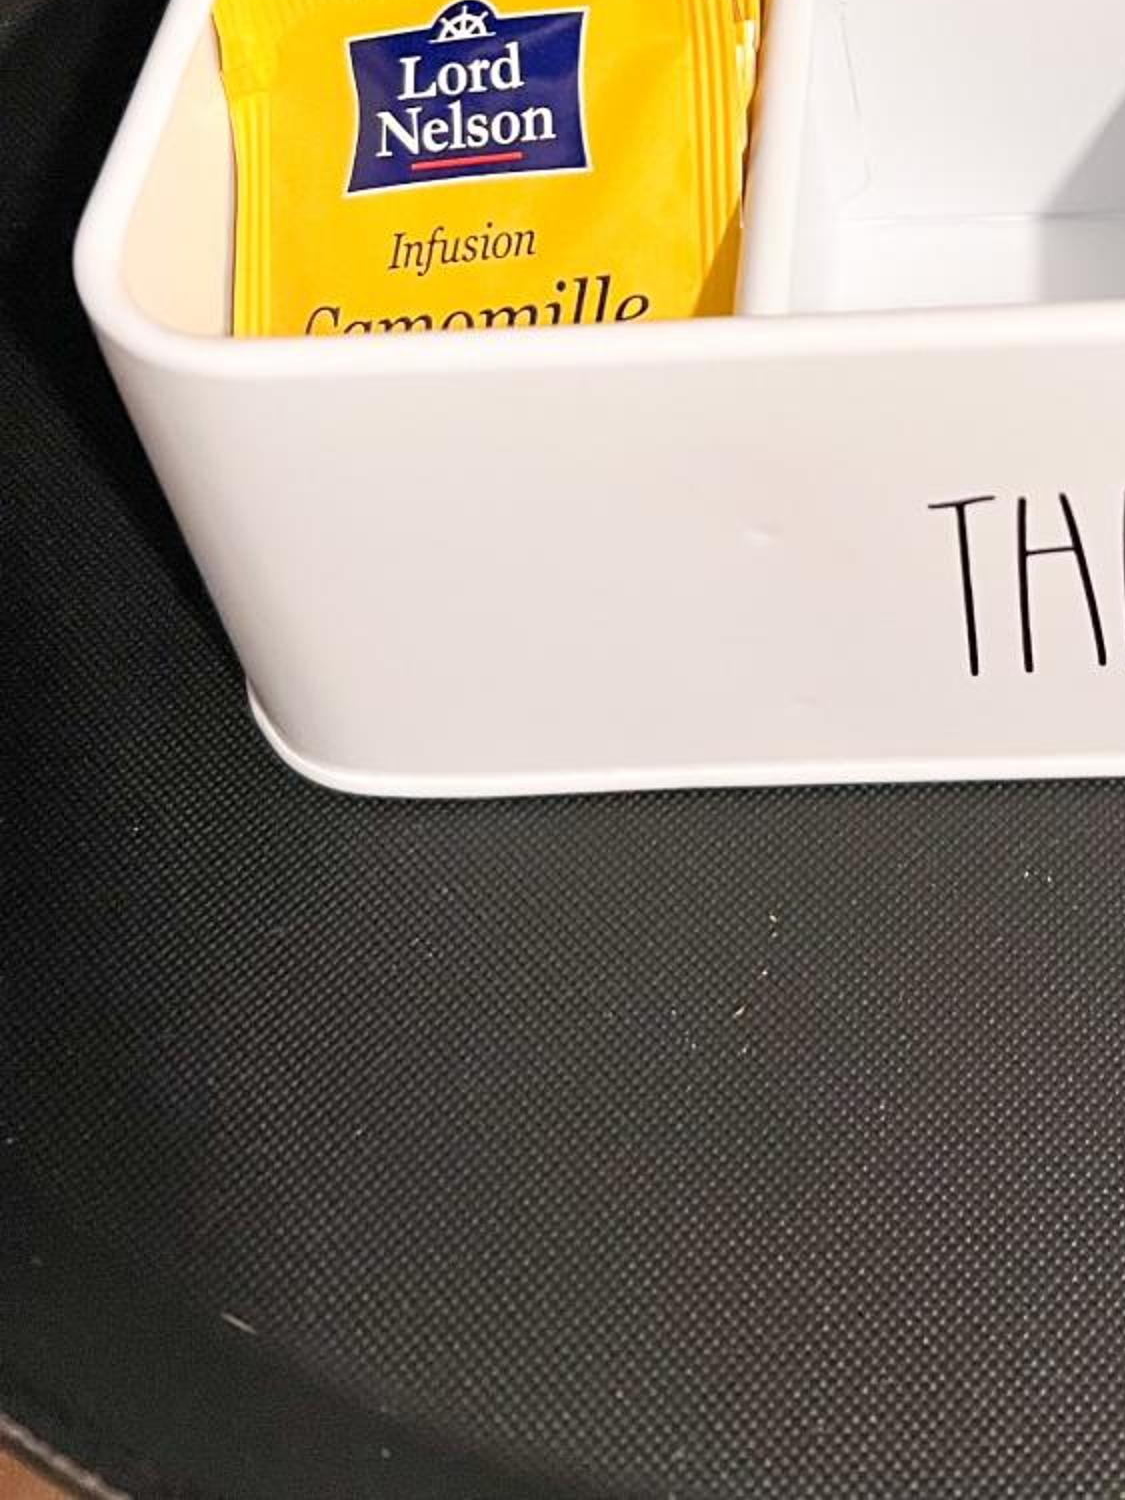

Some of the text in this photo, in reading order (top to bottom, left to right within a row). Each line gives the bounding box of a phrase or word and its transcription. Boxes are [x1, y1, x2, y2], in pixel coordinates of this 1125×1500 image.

[397, 42, 524, 101] Lord
[376, 101, 556, 158] Nelson
[388, 221, 536, 277] Infusion
